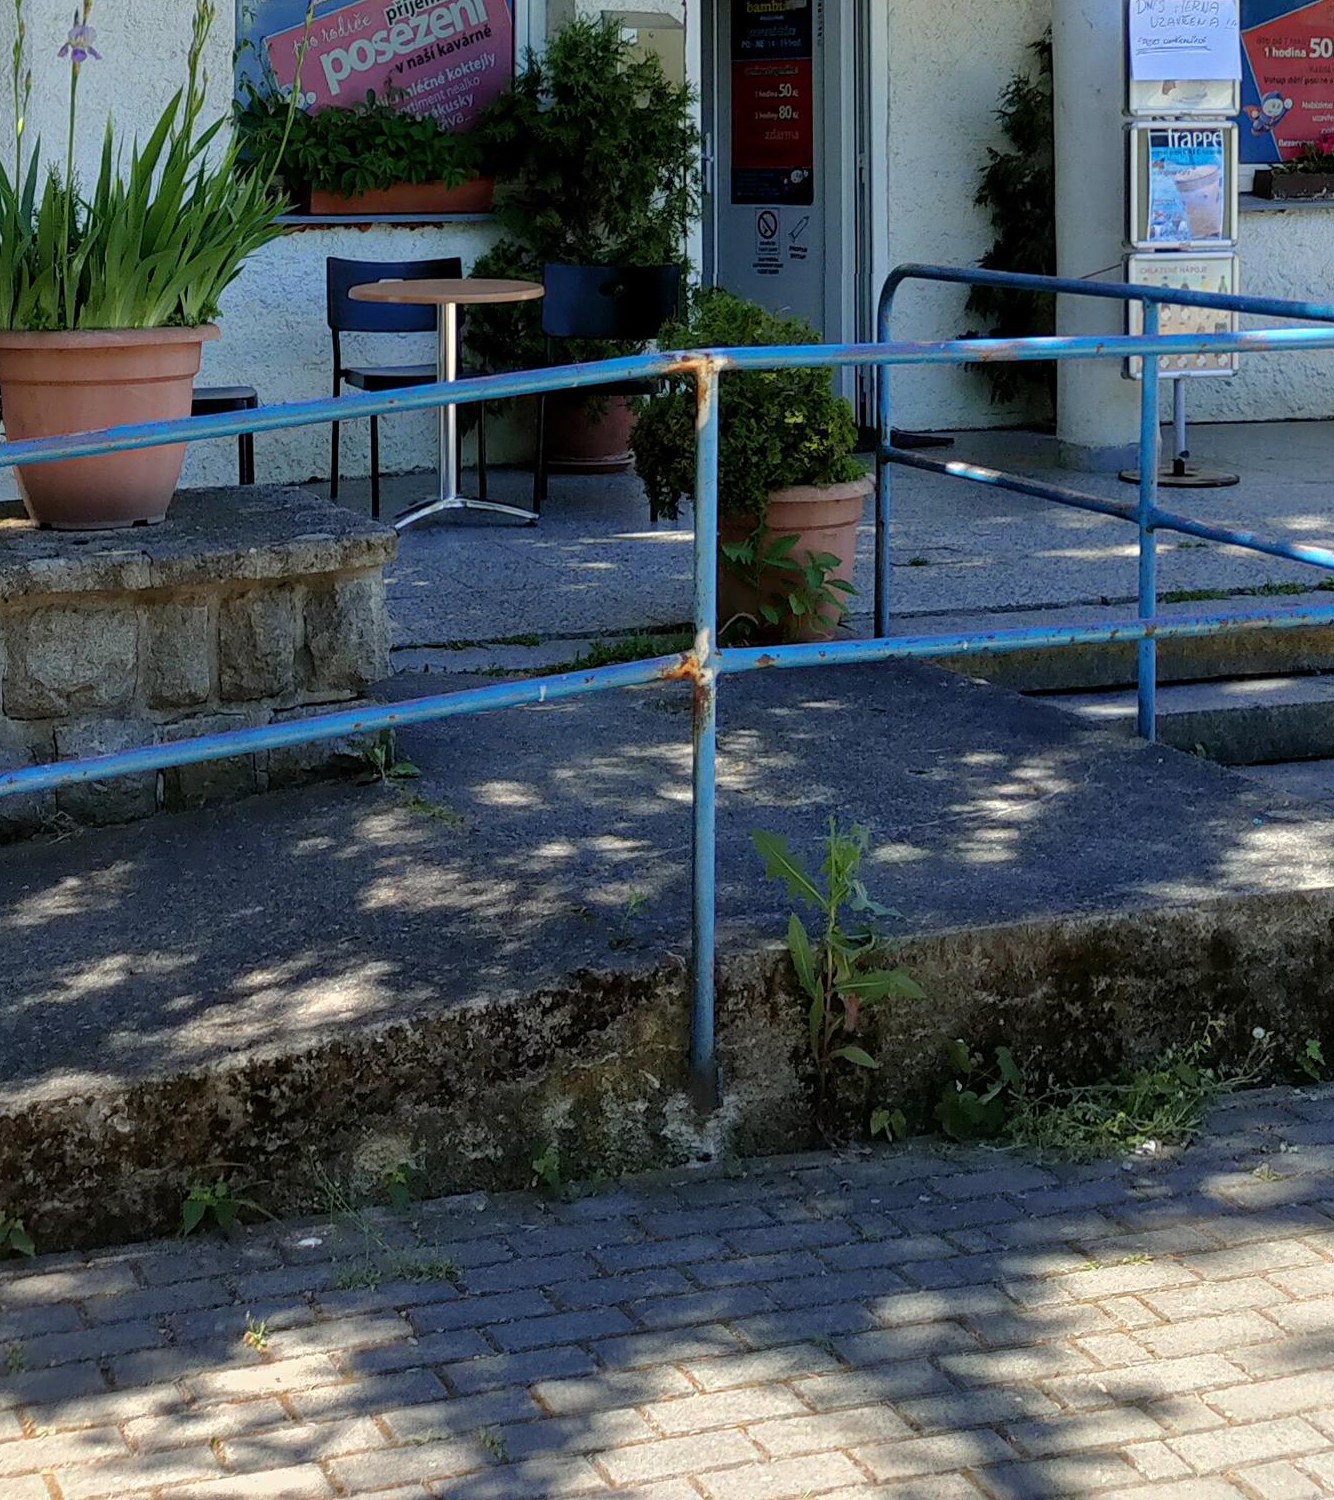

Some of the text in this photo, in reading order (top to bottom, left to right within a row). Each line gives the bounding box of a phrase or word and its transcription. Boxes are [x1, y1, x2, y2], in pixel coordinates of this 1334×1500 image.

[322, 12, 371, 43] rodiče
[395, 25, 492, 73] v naší kavárně
[1264, 48, 1269, 57] 1
[1272, 47, 1306, 57] hodina
[1309, 38, 1333, 58] 50
[447, 53, 495, 81] koktejly
[448, 77, 480, 97] nealko
[779, 84, 792, 97] 50
[779, 105, 792, 119] 80
